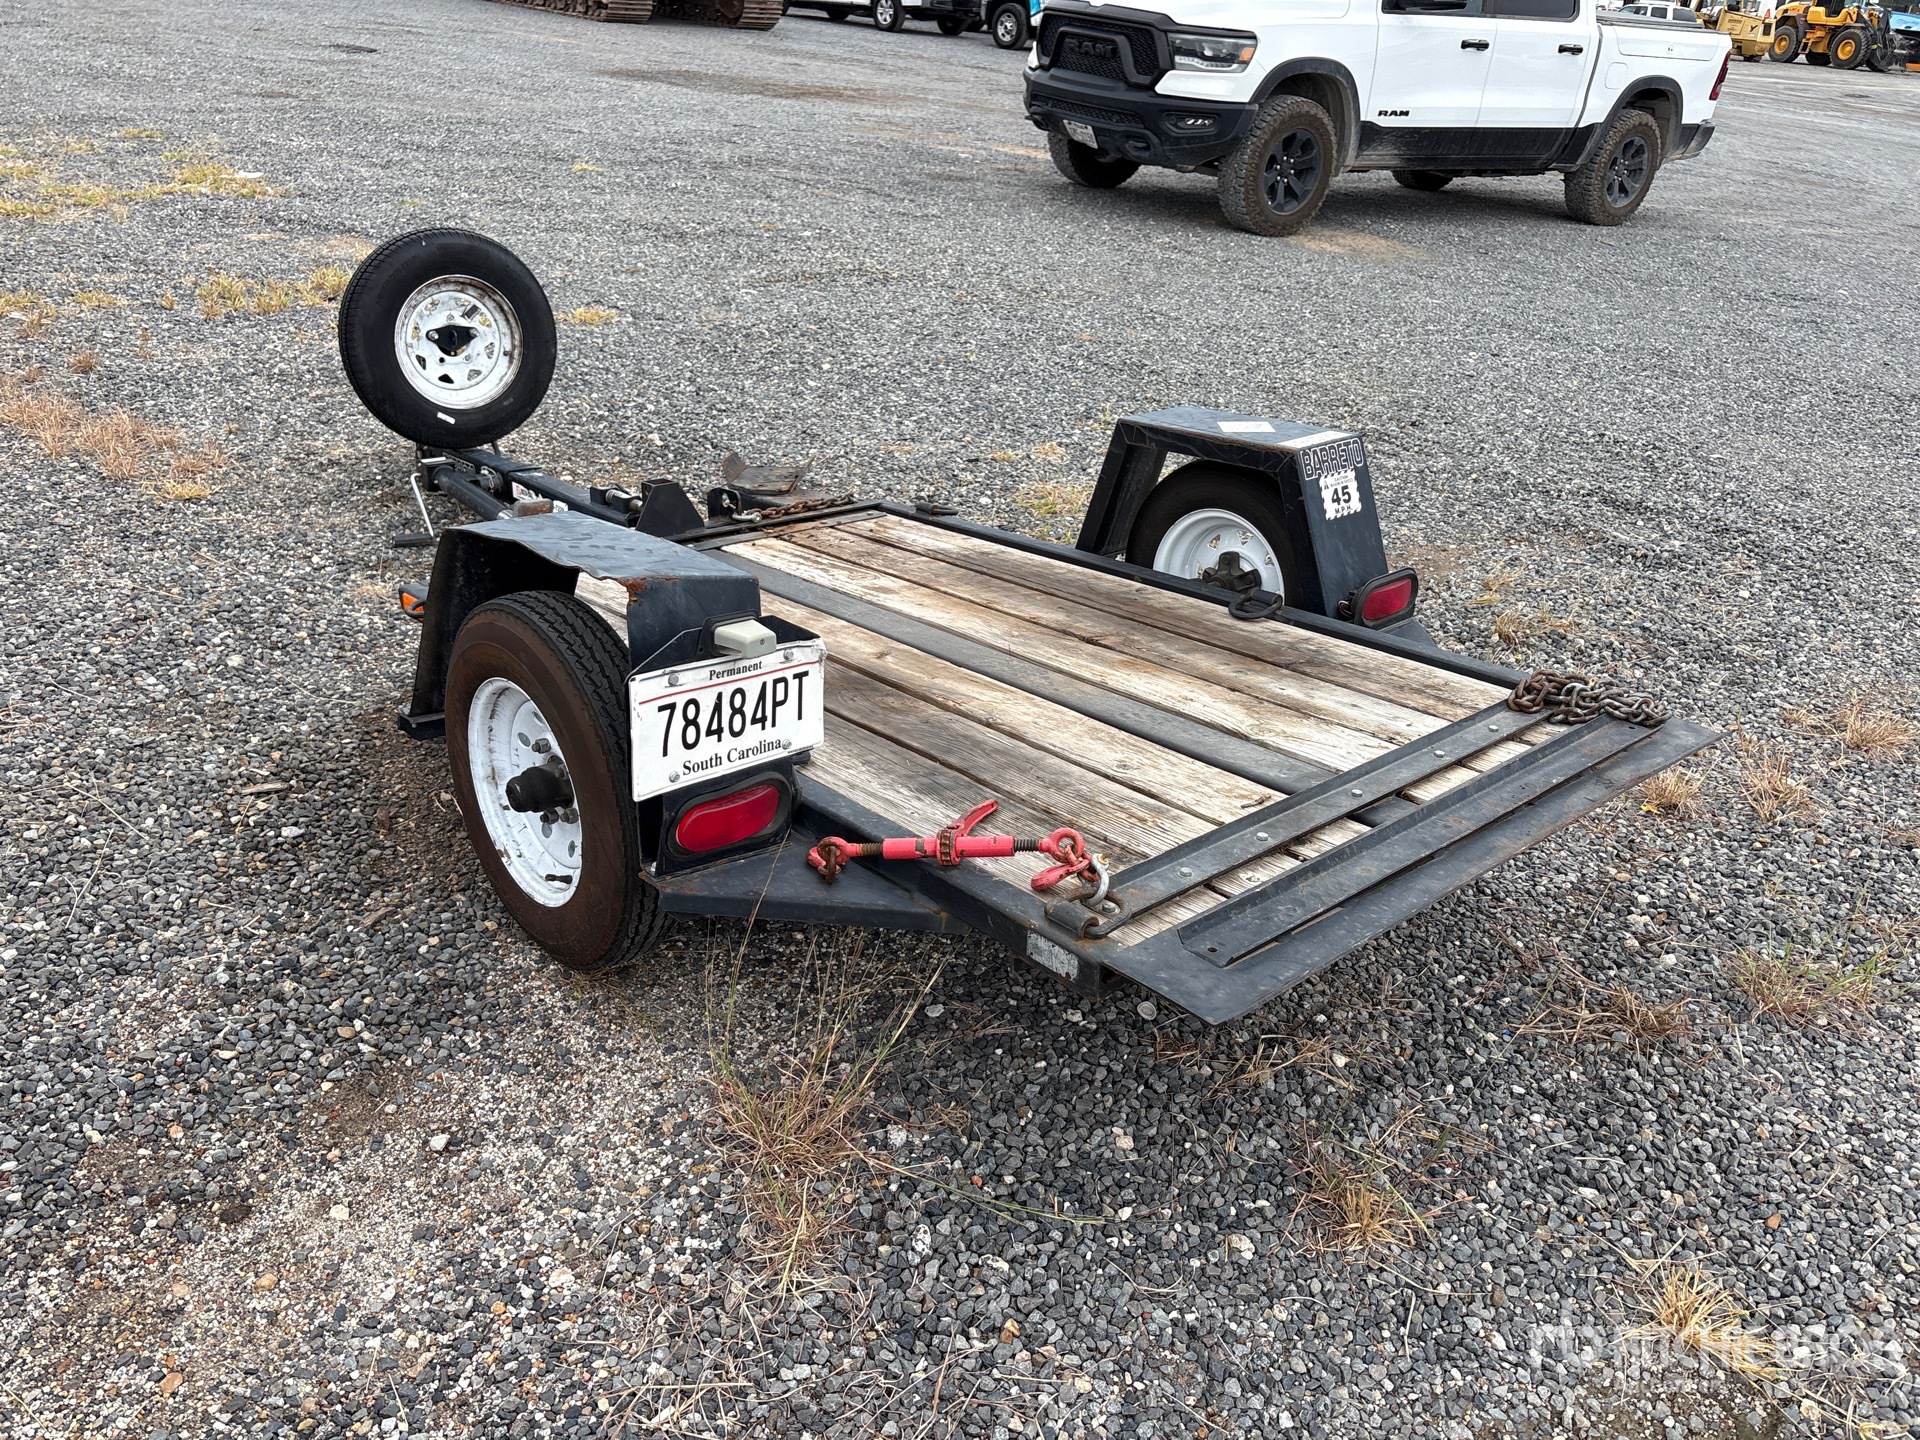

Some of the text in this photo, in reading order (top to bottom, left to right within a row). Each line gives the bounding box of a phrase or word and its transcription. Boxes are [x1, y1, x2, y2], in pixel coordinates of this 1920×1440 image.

[1062, 36, 1113, 57] RAM
[1377, 109, 1410, 117] RAM
[1300, 437, 1364, 480] BARRETO
[1331, 485, 1352, 506] 45
[709, 660, 763, 681] Permanent
[657, 670, 809, 757] 78484PT
[682, 738, 782, 776] South Carolina
